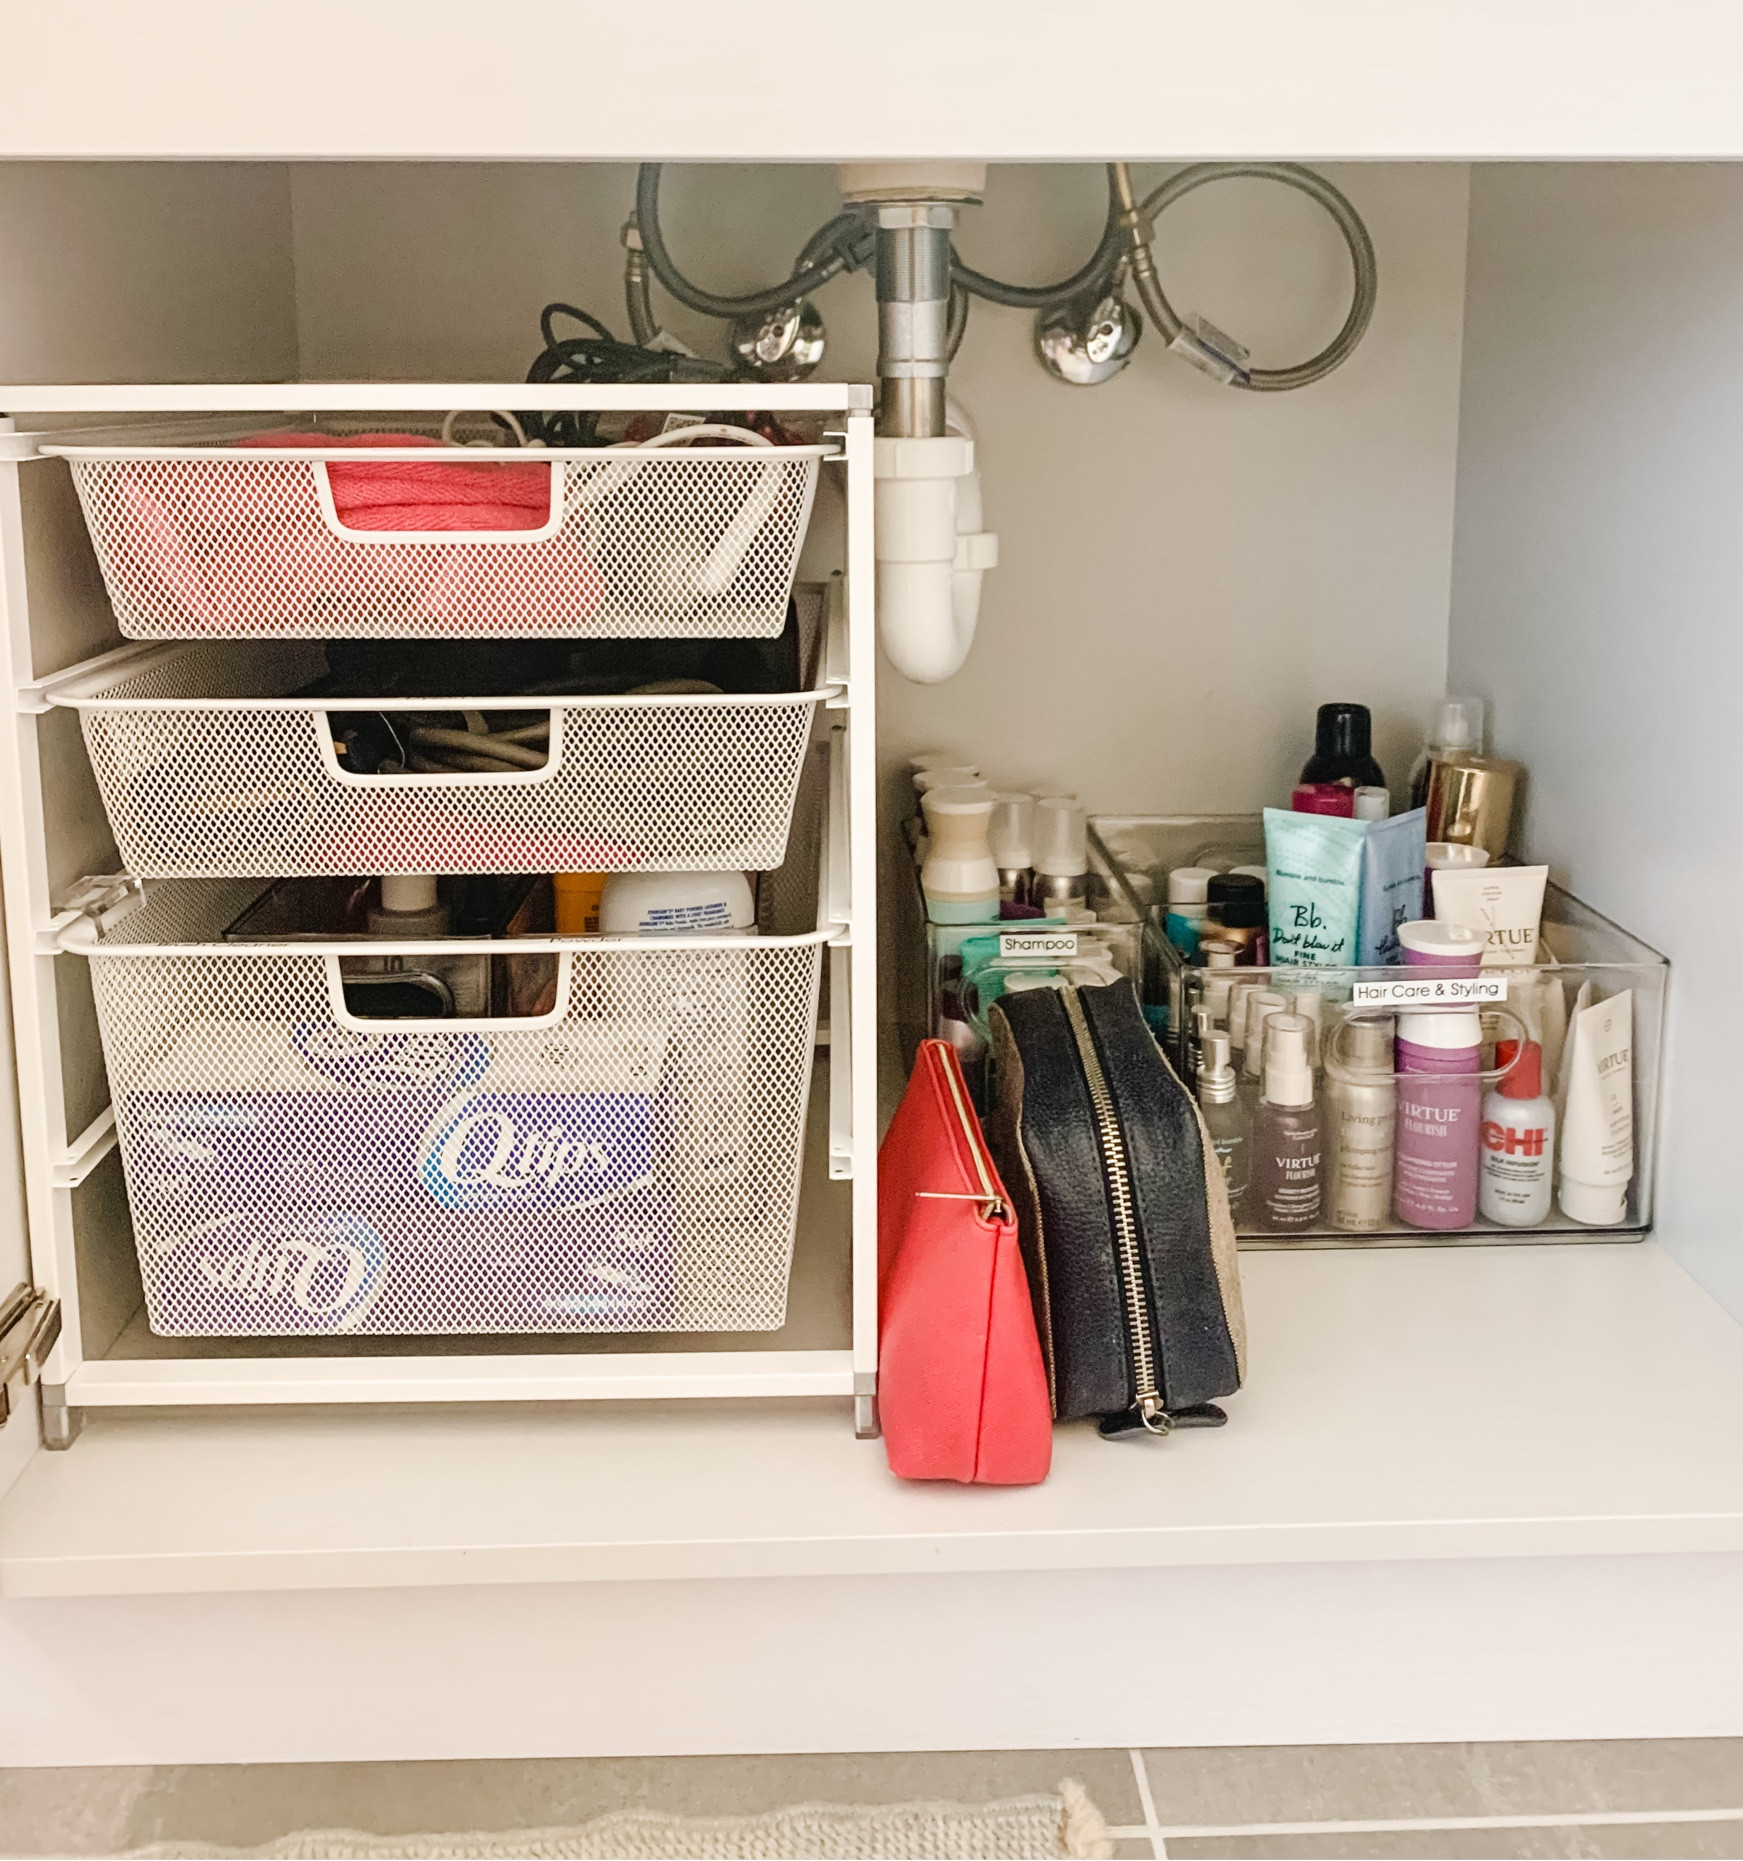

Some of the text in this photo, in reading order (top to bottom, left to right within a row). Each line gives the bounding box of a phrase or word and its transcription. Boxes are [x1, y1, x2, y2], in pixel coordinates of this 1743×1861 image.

[1005, 937, 1075, 951] Shampoo
[1294, 950, 1317, 961] FINE
[1358, 982, 1499, 999] Hair Care & Styling
[1481, 1120, 1544, 1157] CHI
[1275, 1153, 1322, 1169] VIRTUE
